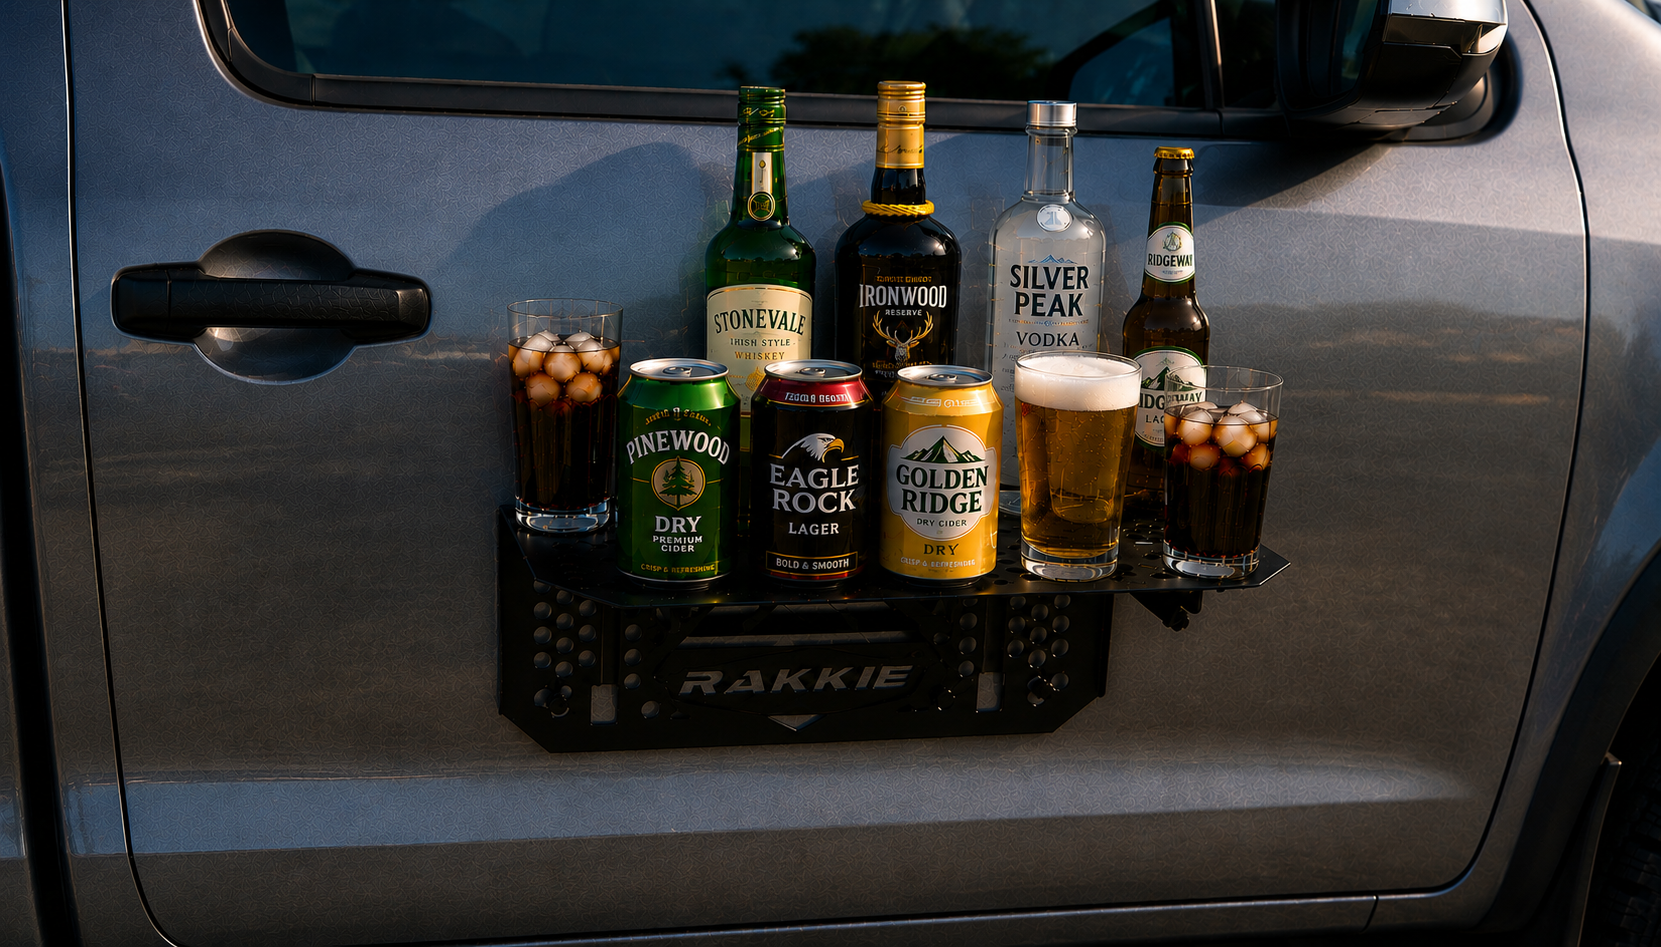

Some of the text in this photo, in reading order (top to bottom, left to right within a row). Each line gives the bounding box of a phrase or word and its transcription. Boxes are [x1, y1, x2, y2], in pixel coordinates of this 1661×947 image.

[1010, 264, 1089, 290] SILVER
[859, 284, 947, 308] IRONWOOD
[1014, 291, 1084, 317] PEAK
[714, 308, 806, 335] STONEVALE
[761, 338, 791, 347] STYLE
[1016, 331, 1080, 347] VODKA
[735, 351, 785, 361] WHISKEY
[626, 429, 730, 465] PINEWOOD
[769, 462, 859, 489] EAGLE
[896, 464, 989, 490] GOLDEN
[772, 488, 856, 513] ROCK
[901, 488, 982, 514] RIDGE
[654, 515, 702, 534] DRY
[788, 522, 840, 535] LAGER
[916, 518, 968, 528] DRY CIDER
[652, 535, 703, 544] PREMIUM
[661, 544, 695, 553] CIDER
[923, 543, 959, 556] DRY
[776, 558, 850, 571] BOLD & SMOOTH
[679, 665, 913, 695] RAKKIE
